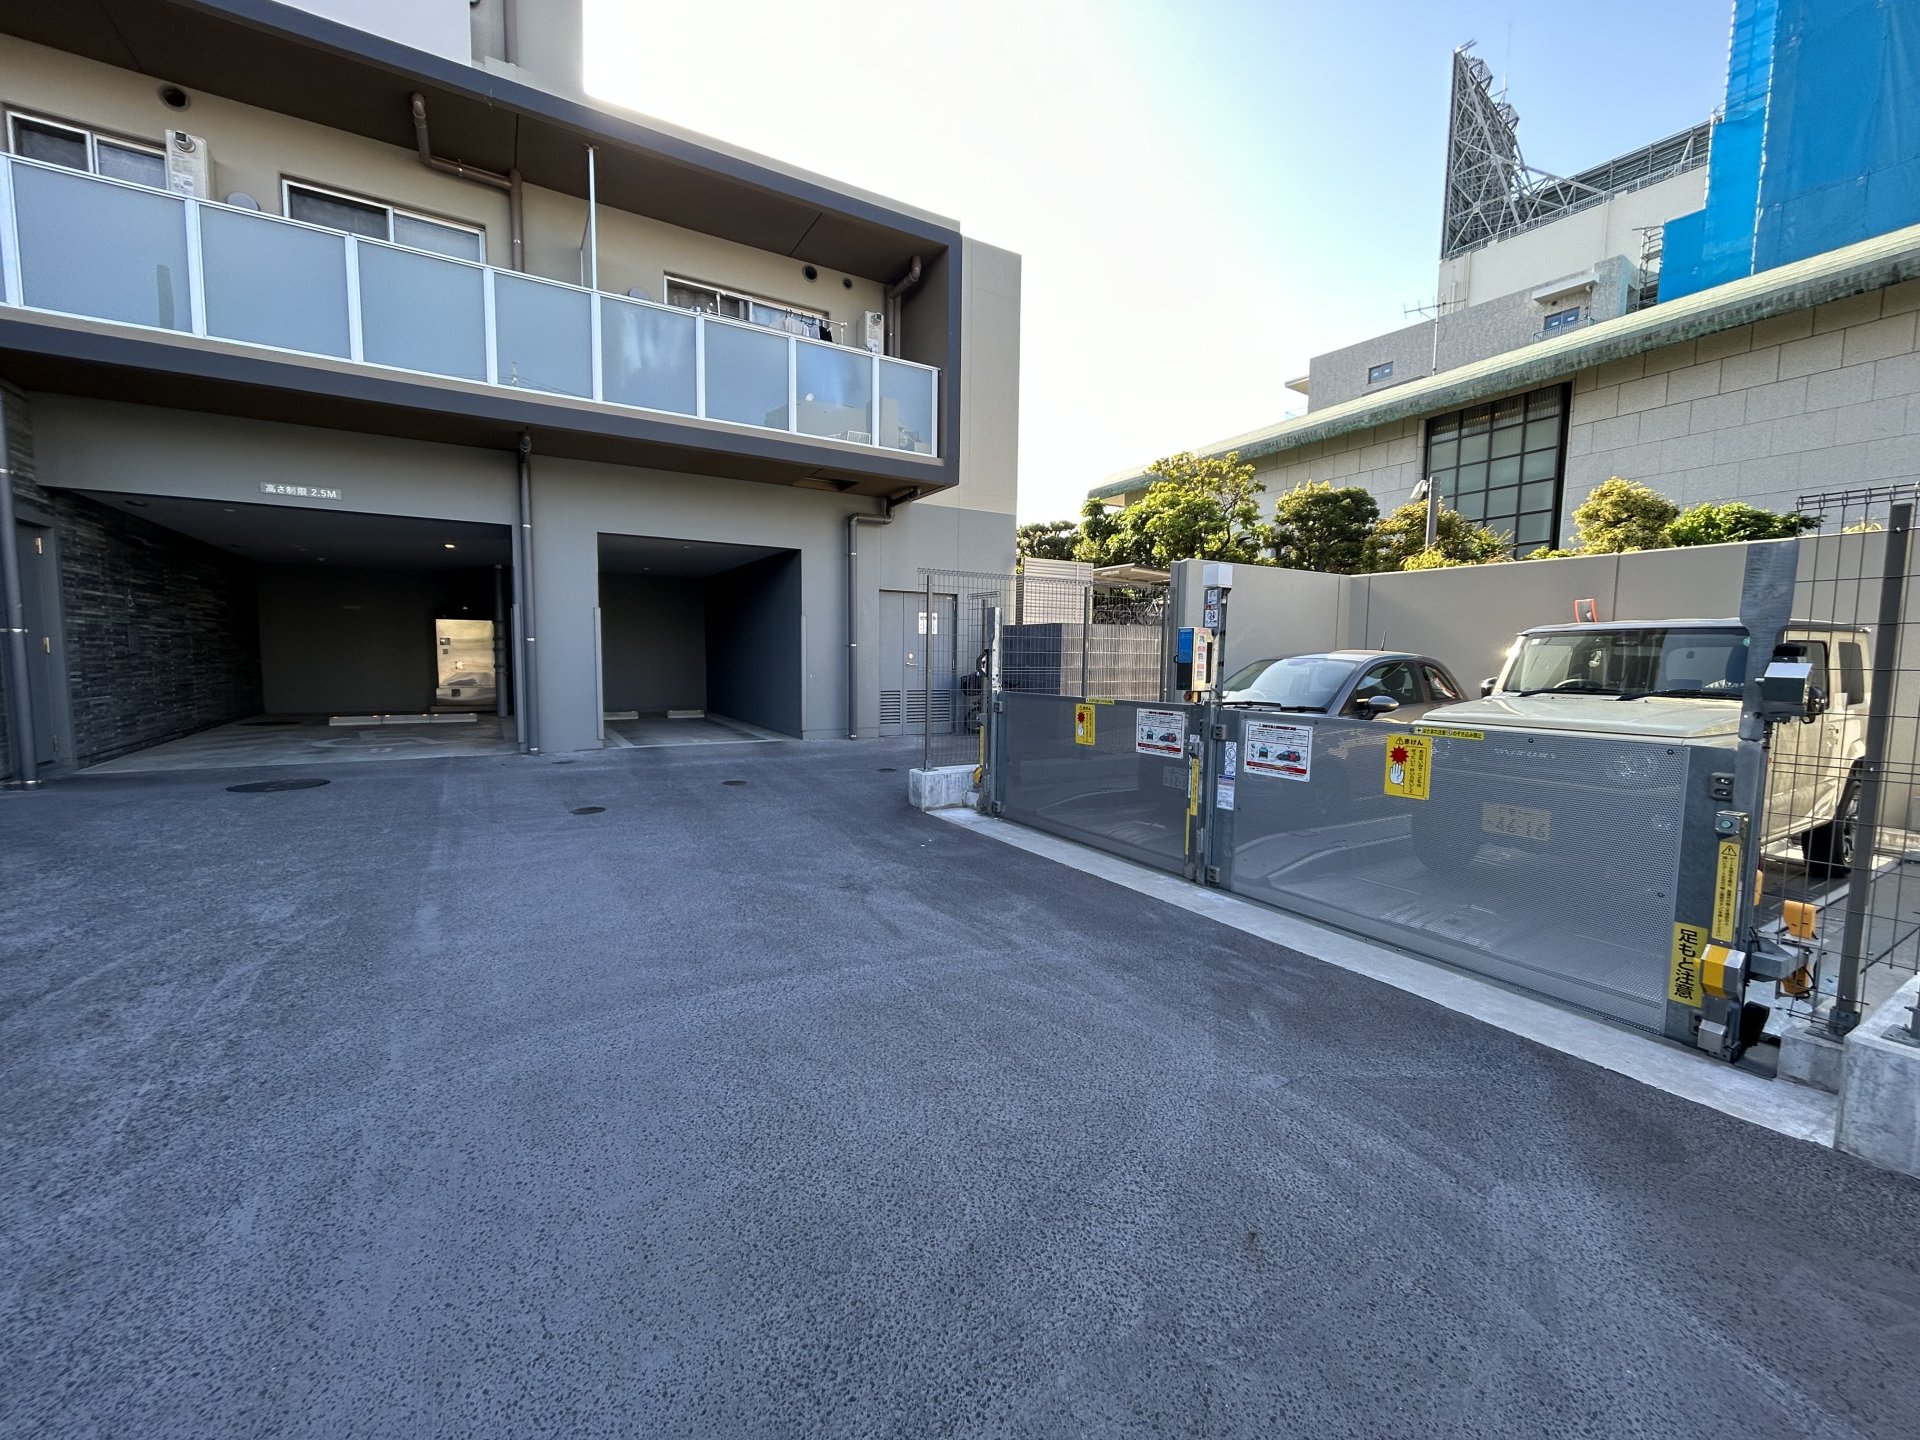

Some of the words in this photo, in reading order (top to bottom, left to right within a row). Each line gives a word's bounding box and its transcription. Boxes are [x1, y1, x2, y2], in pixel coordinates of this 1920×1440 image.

[265, 484, 308, 496] 高さ制限
[310, 488, 337, 498] 2.5M
[1404, 738, 1424, 746] きけん
[1674, 928, 1698, 1000] 足もと注意
